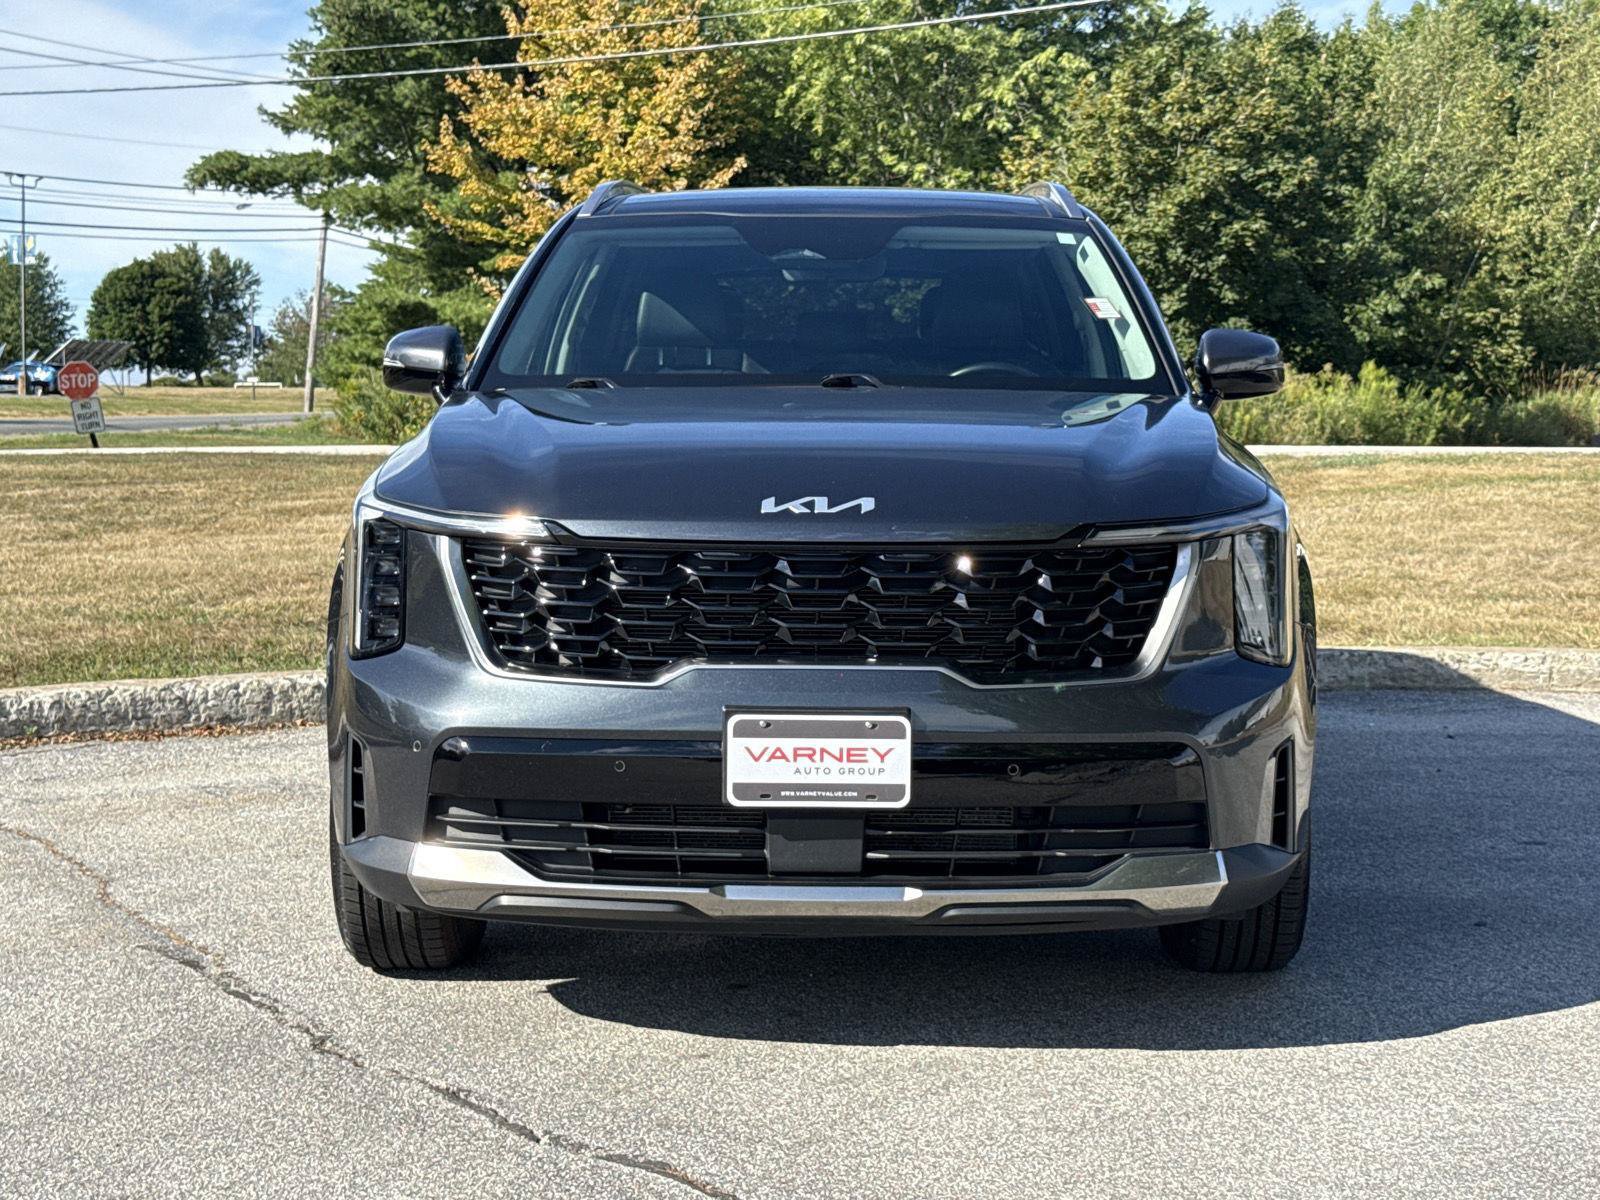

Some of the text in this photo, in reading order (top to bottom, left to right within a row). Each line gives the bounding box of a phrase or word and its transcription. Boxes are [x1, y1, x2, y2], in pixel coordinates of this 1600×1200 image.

[61, 373, 96, 389] STOP
[80, 402, 92, 410] NO
[77, 410, 99, 421] RIGHT
[80, 421, 100, 431] TURN
[761, 496, 875, 514] KIA
[744, 746, 895, 763] VARNEY
[793, 767, 886, 776] AUTO GROUP
